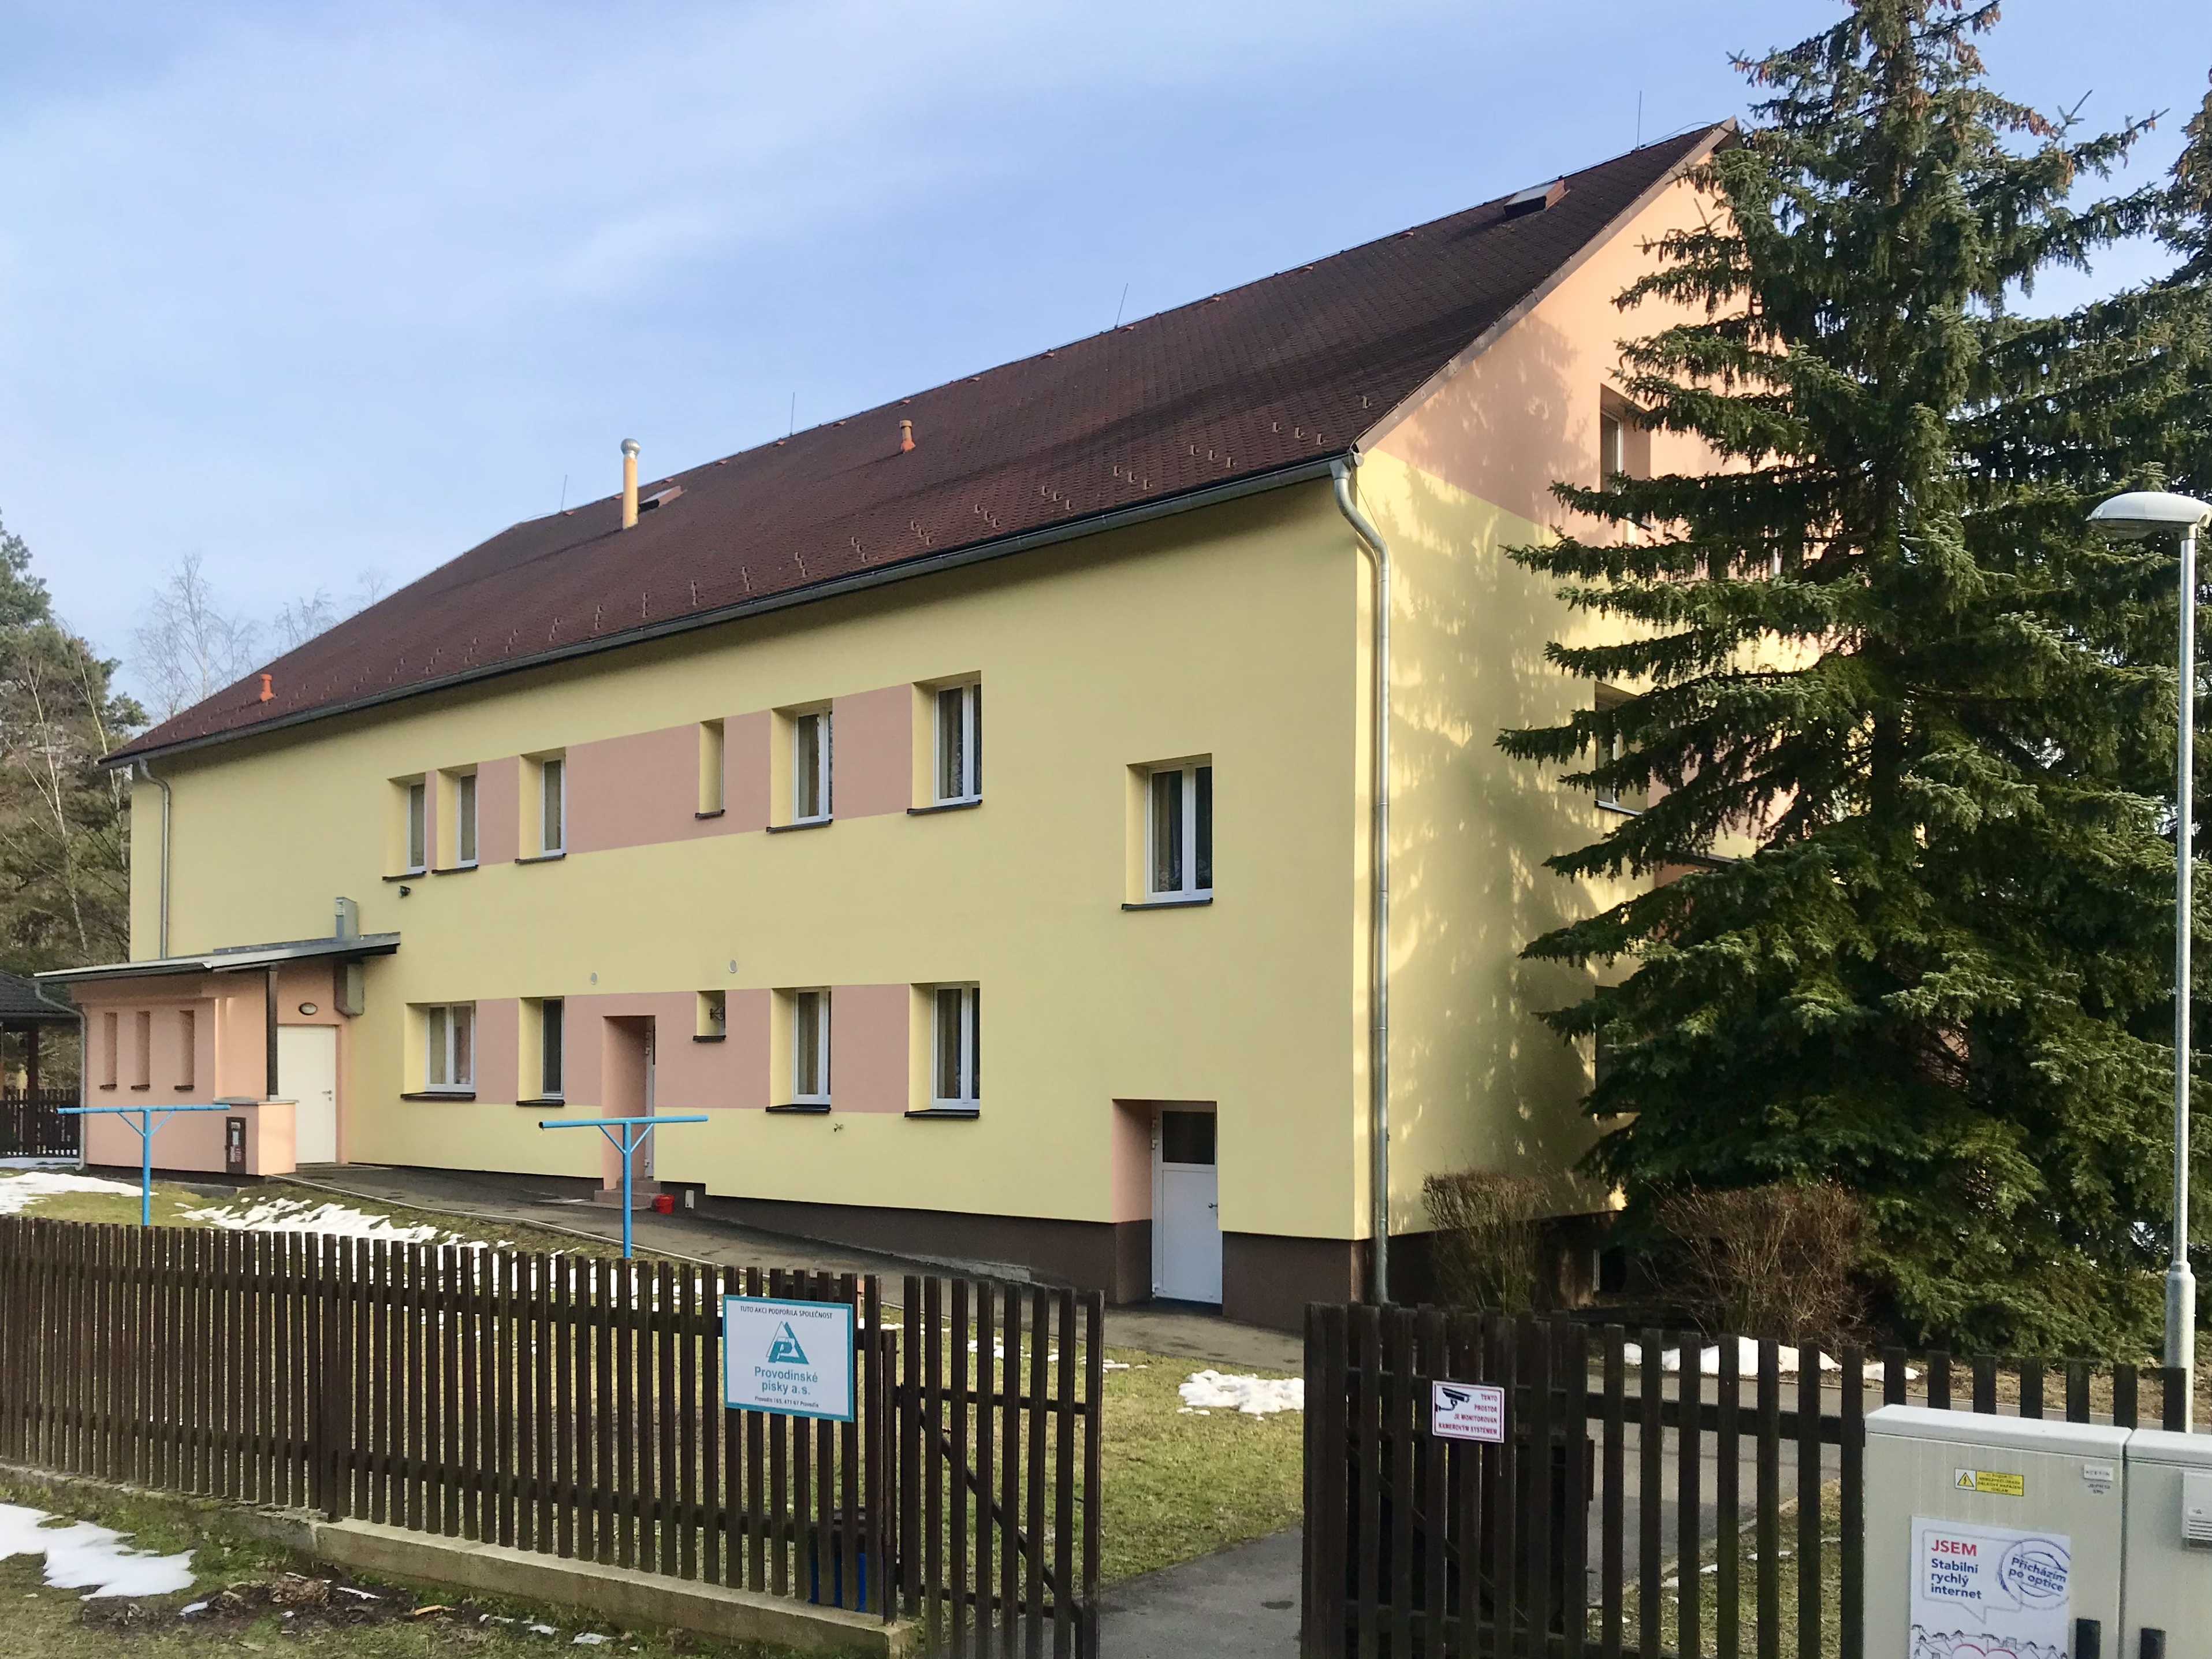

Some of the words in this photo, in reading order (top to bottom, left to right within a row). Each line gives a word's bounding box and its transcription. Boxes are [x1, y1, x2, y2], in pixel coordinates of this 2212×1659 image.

[768, 1308, 798, 1316] PODPOŘILA
[799, 1310, 833, 1319] SPOLEČNOST
[762, 1380, 788, 1395] písky
[792, 1385, 810, 1395] a.s.
[1481, 1393, 1498, 1402] TENTO
[1474, 1404, 1498, 1413] PROSTOR
[1931, 1539, 1977, 1557] JSEM
[1931, 1558, 1979, 1574] Stabilní
[2011, 1557, 2066, 1583] Přicházím
[1931, 1572, 1969, 1587] rychlý
[2008, 1568, 2024, 1579] po
[2028, 1574, 2064, 1593] optice
[1931, 1583, 1982, 1600] internet
